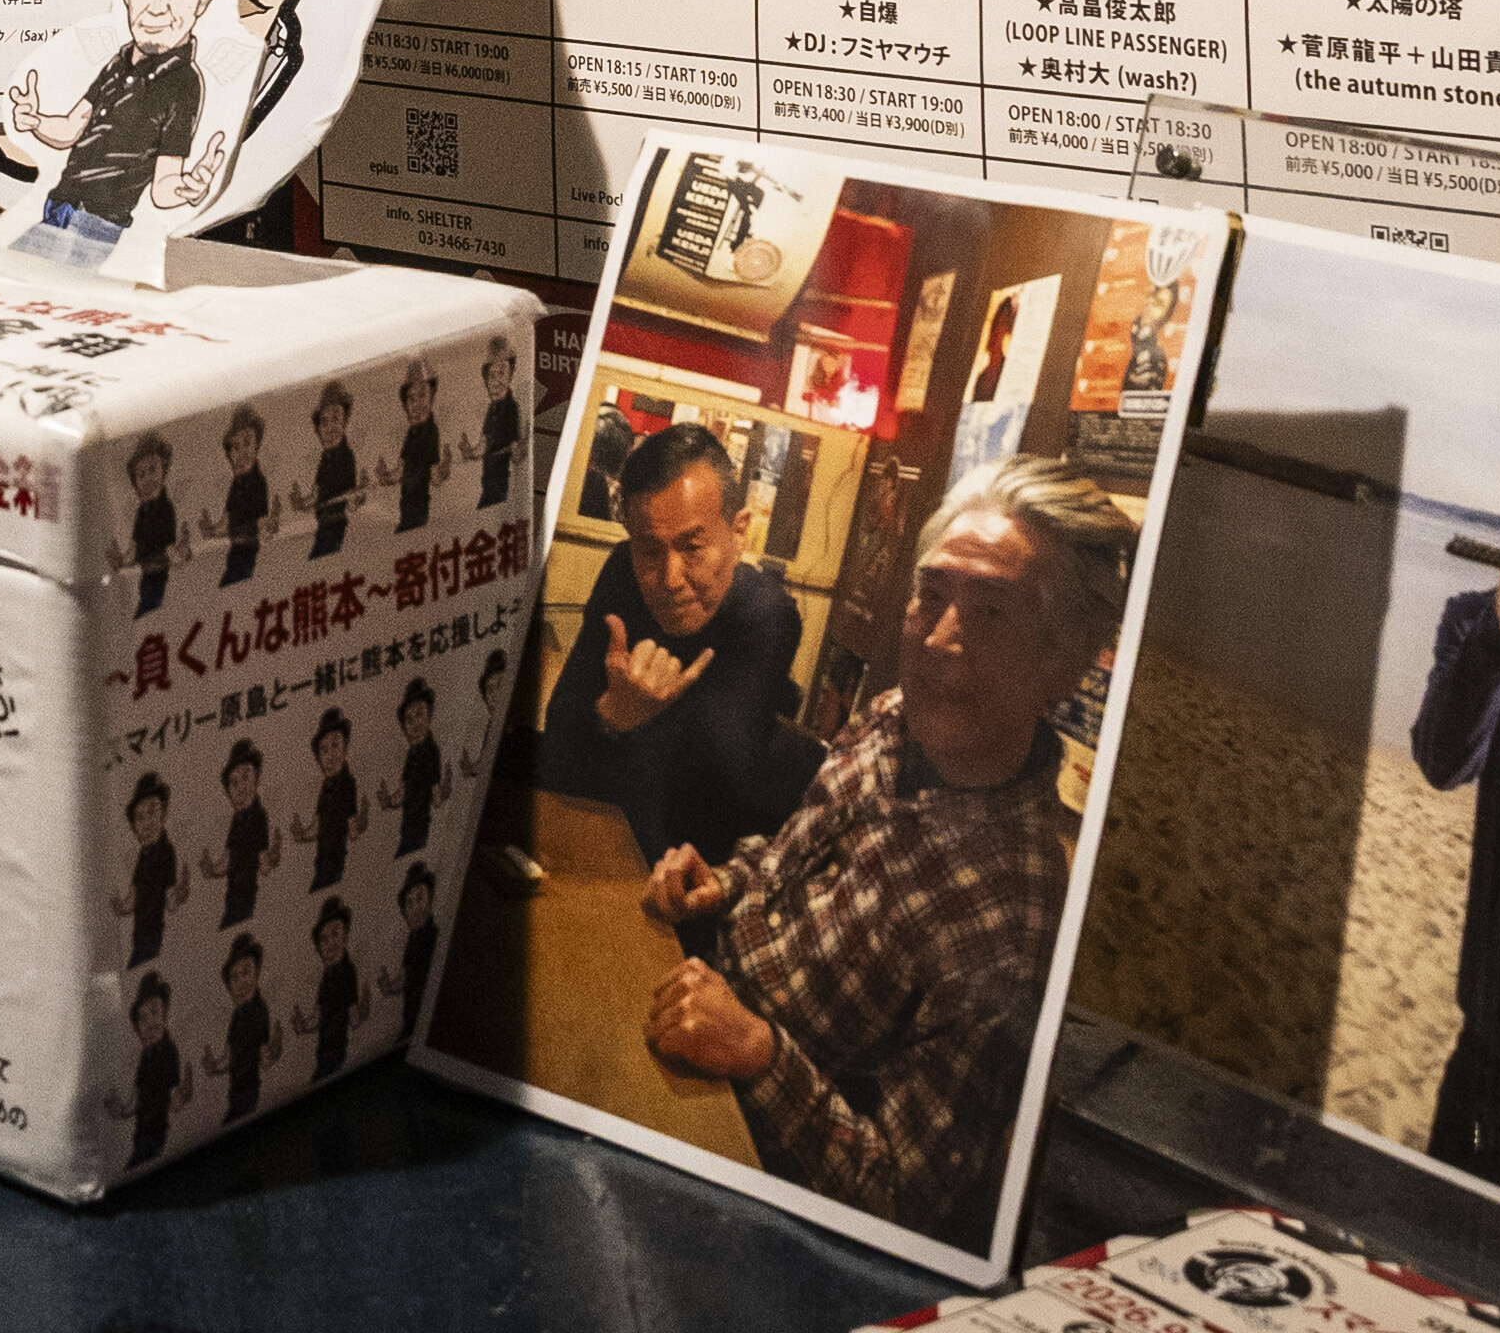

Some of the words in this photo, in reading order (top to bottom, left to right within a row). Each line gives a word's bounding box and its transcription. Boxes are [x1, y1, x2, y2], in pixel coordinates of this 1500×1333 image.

[1005, 20, 1060, 44] (LOOP
[1065, 26, 1106, 48] LINE
[1110, 33, 1228, 64] PASSENGER)
[1118, 63, 1198, 96] (wash?)
[1294, 67, 1342, 93] (the
[1347, 76, 1438, 102] autumn
